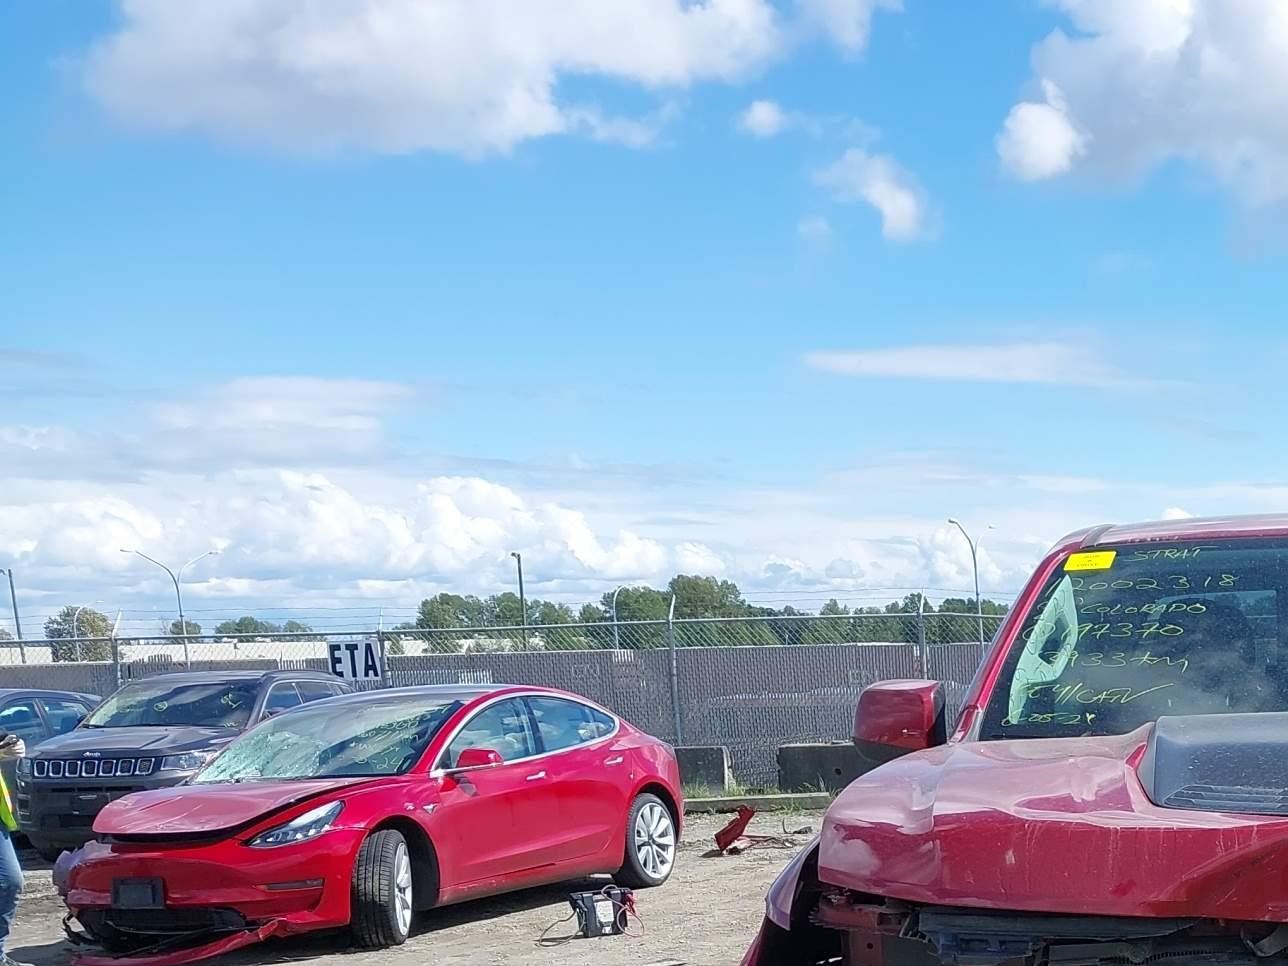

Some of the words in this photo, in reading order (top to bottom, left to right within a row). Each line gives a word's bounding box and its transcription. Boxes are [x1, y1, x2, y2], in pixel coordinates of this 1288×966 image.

[1044, 574, 1240, 598] 12002318
[1080, 602, 1207, 616] COLORADO
[329, 643, 379, 678] ETA
